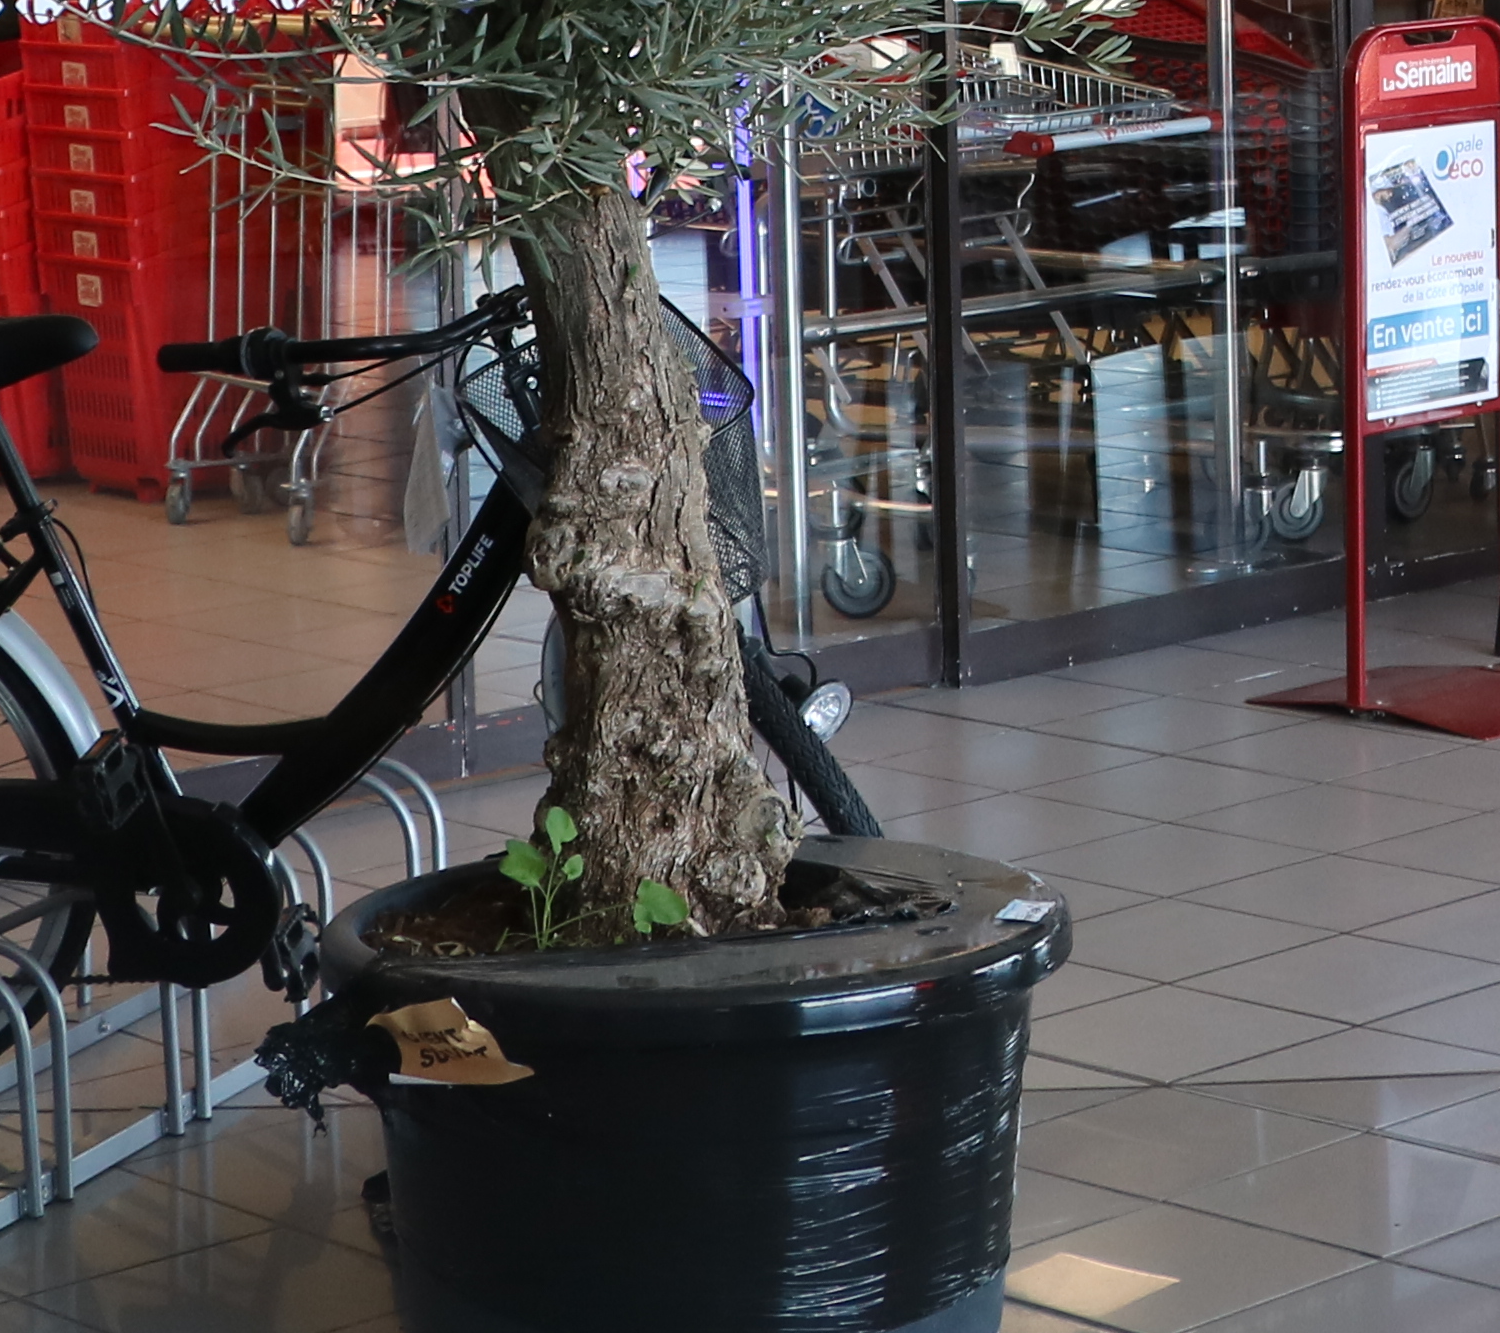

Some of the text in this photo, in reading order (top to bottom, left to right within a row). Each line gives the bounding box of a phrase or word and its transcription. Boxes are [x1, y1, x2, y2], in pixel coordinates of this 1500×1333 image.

[1383, 55, 1473, 92] La Semaine
[1431, 249, 1484, 267] Le nouveau
[1371, 265, 1485, 293] rendez-vous économique
[1402, 293, 1415, 304] de
[1416, 291, 1424, 302] la
[1425, 286, 1449, 301] Côte
[1373, 306, 1483, 349] En vente ici
[447, 533, 494, 595] TOPLIFE
